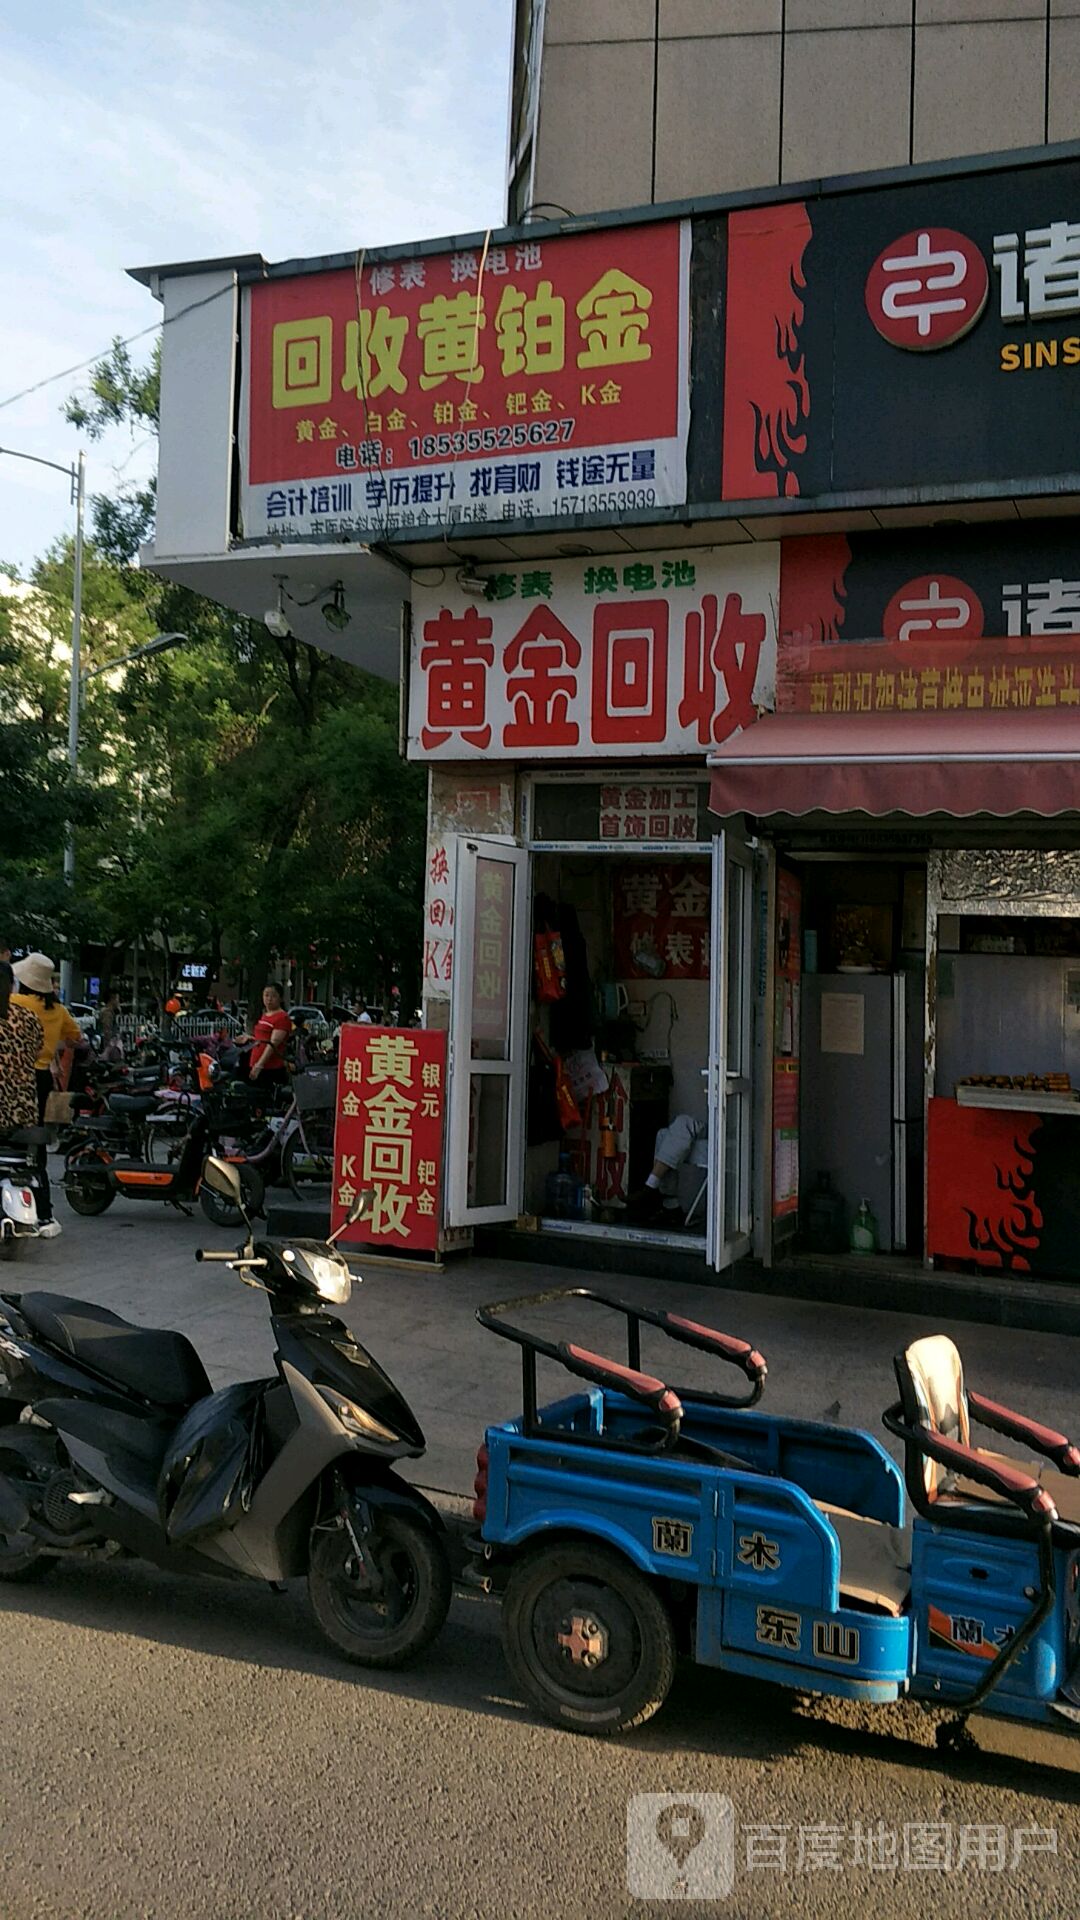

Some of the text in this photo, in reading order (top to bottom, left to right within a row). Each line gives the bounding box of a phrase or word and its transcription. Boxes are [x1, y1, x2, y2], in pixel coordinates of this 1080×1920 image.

[370, 244, 543, 296] 修表 换电池
[271, 267, 653, 410] 回收黄铂金
[266, 449, 656, 519] 会计培训 学历提升 找育财 钱途无量
[484, 559, 696, 601] 修表 换电池
[420, 592, 767, 751] 黄金回收
[601, 786, 696, 810] 黄金加工
[601, 814, 696, 839] 首饰回收
[360, 1035, 419, 1238] 黄金回收
